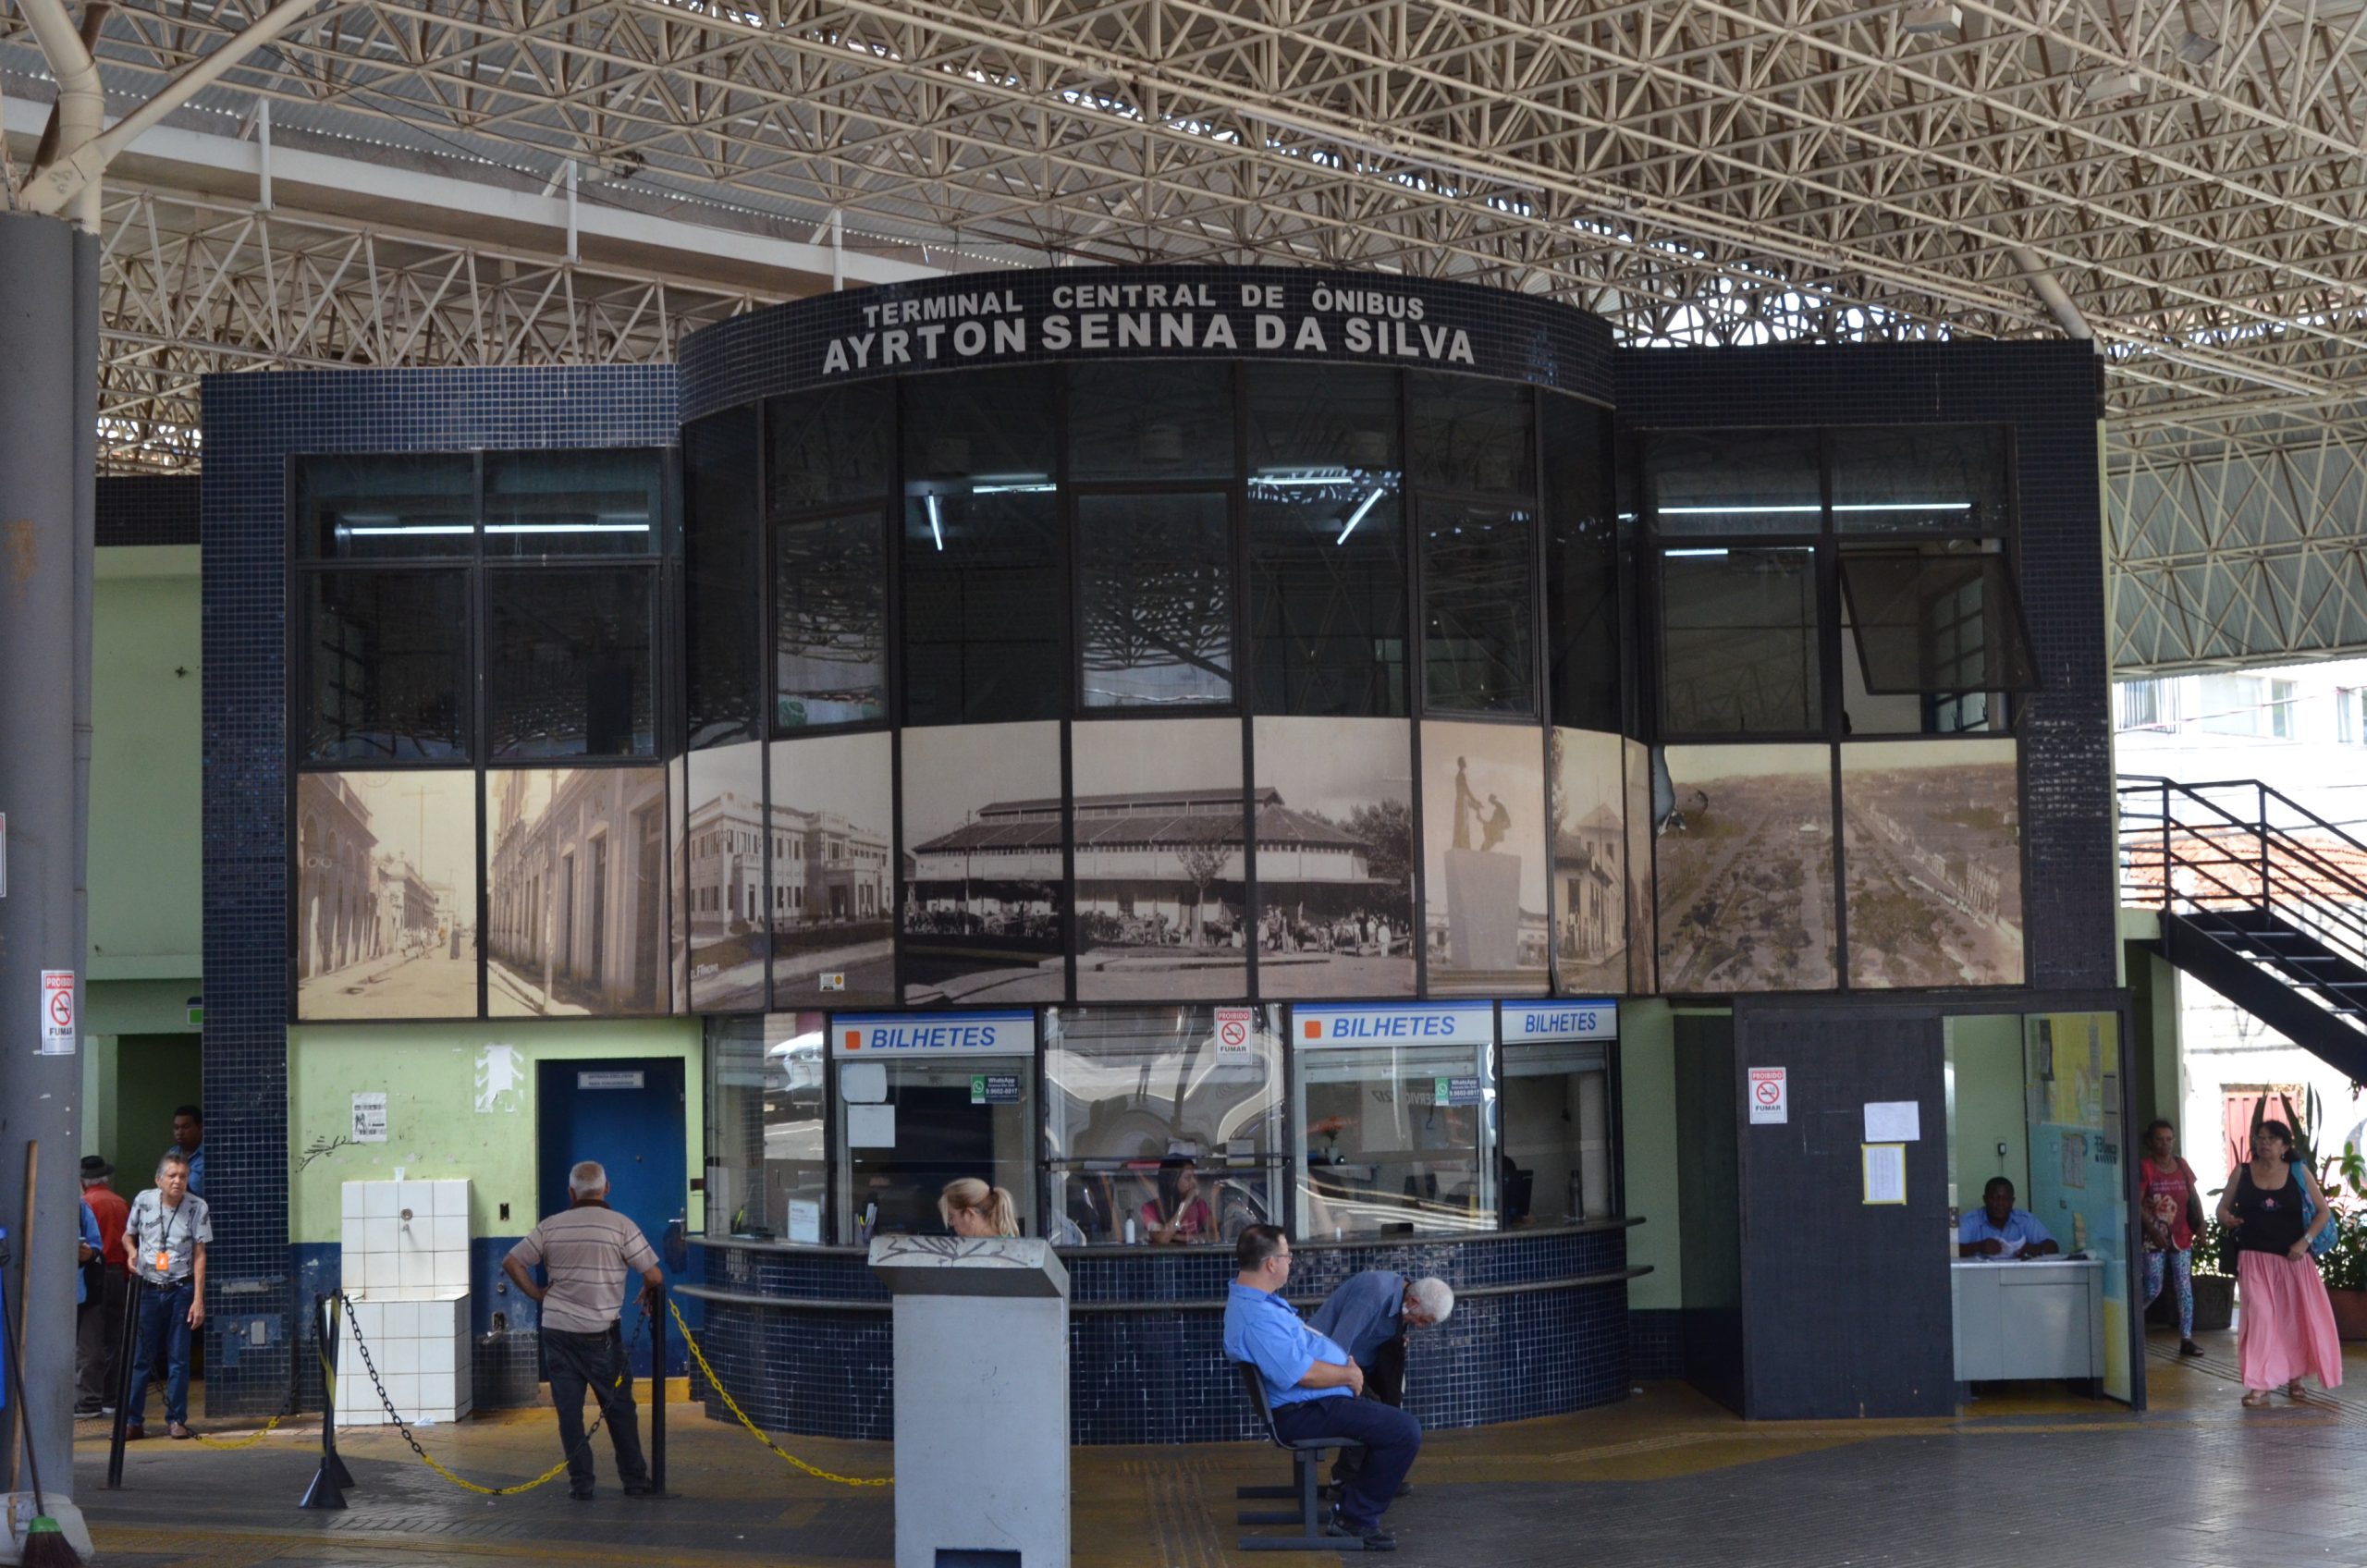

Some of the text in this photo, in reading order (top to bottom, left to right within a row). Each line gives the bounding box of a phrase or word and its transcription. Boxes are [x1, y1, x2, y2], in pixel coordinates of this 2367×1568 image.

[863, 280, 1425, 329] TERMINAL CENTRAL DE ÔNIBUS
[821, 312, 1476, 375] AYRTON SENNA DA SILVA
[49, 1027, 73, 1035] FUMAR
[1331, 1015, 1456, 1037] BILHETES
[1525, 1011, 1597, 1034] BILHETES
[870, 1026, 997, 1048] BILHETES
[1451, 1079, 1478, 1087] WhatsApp
